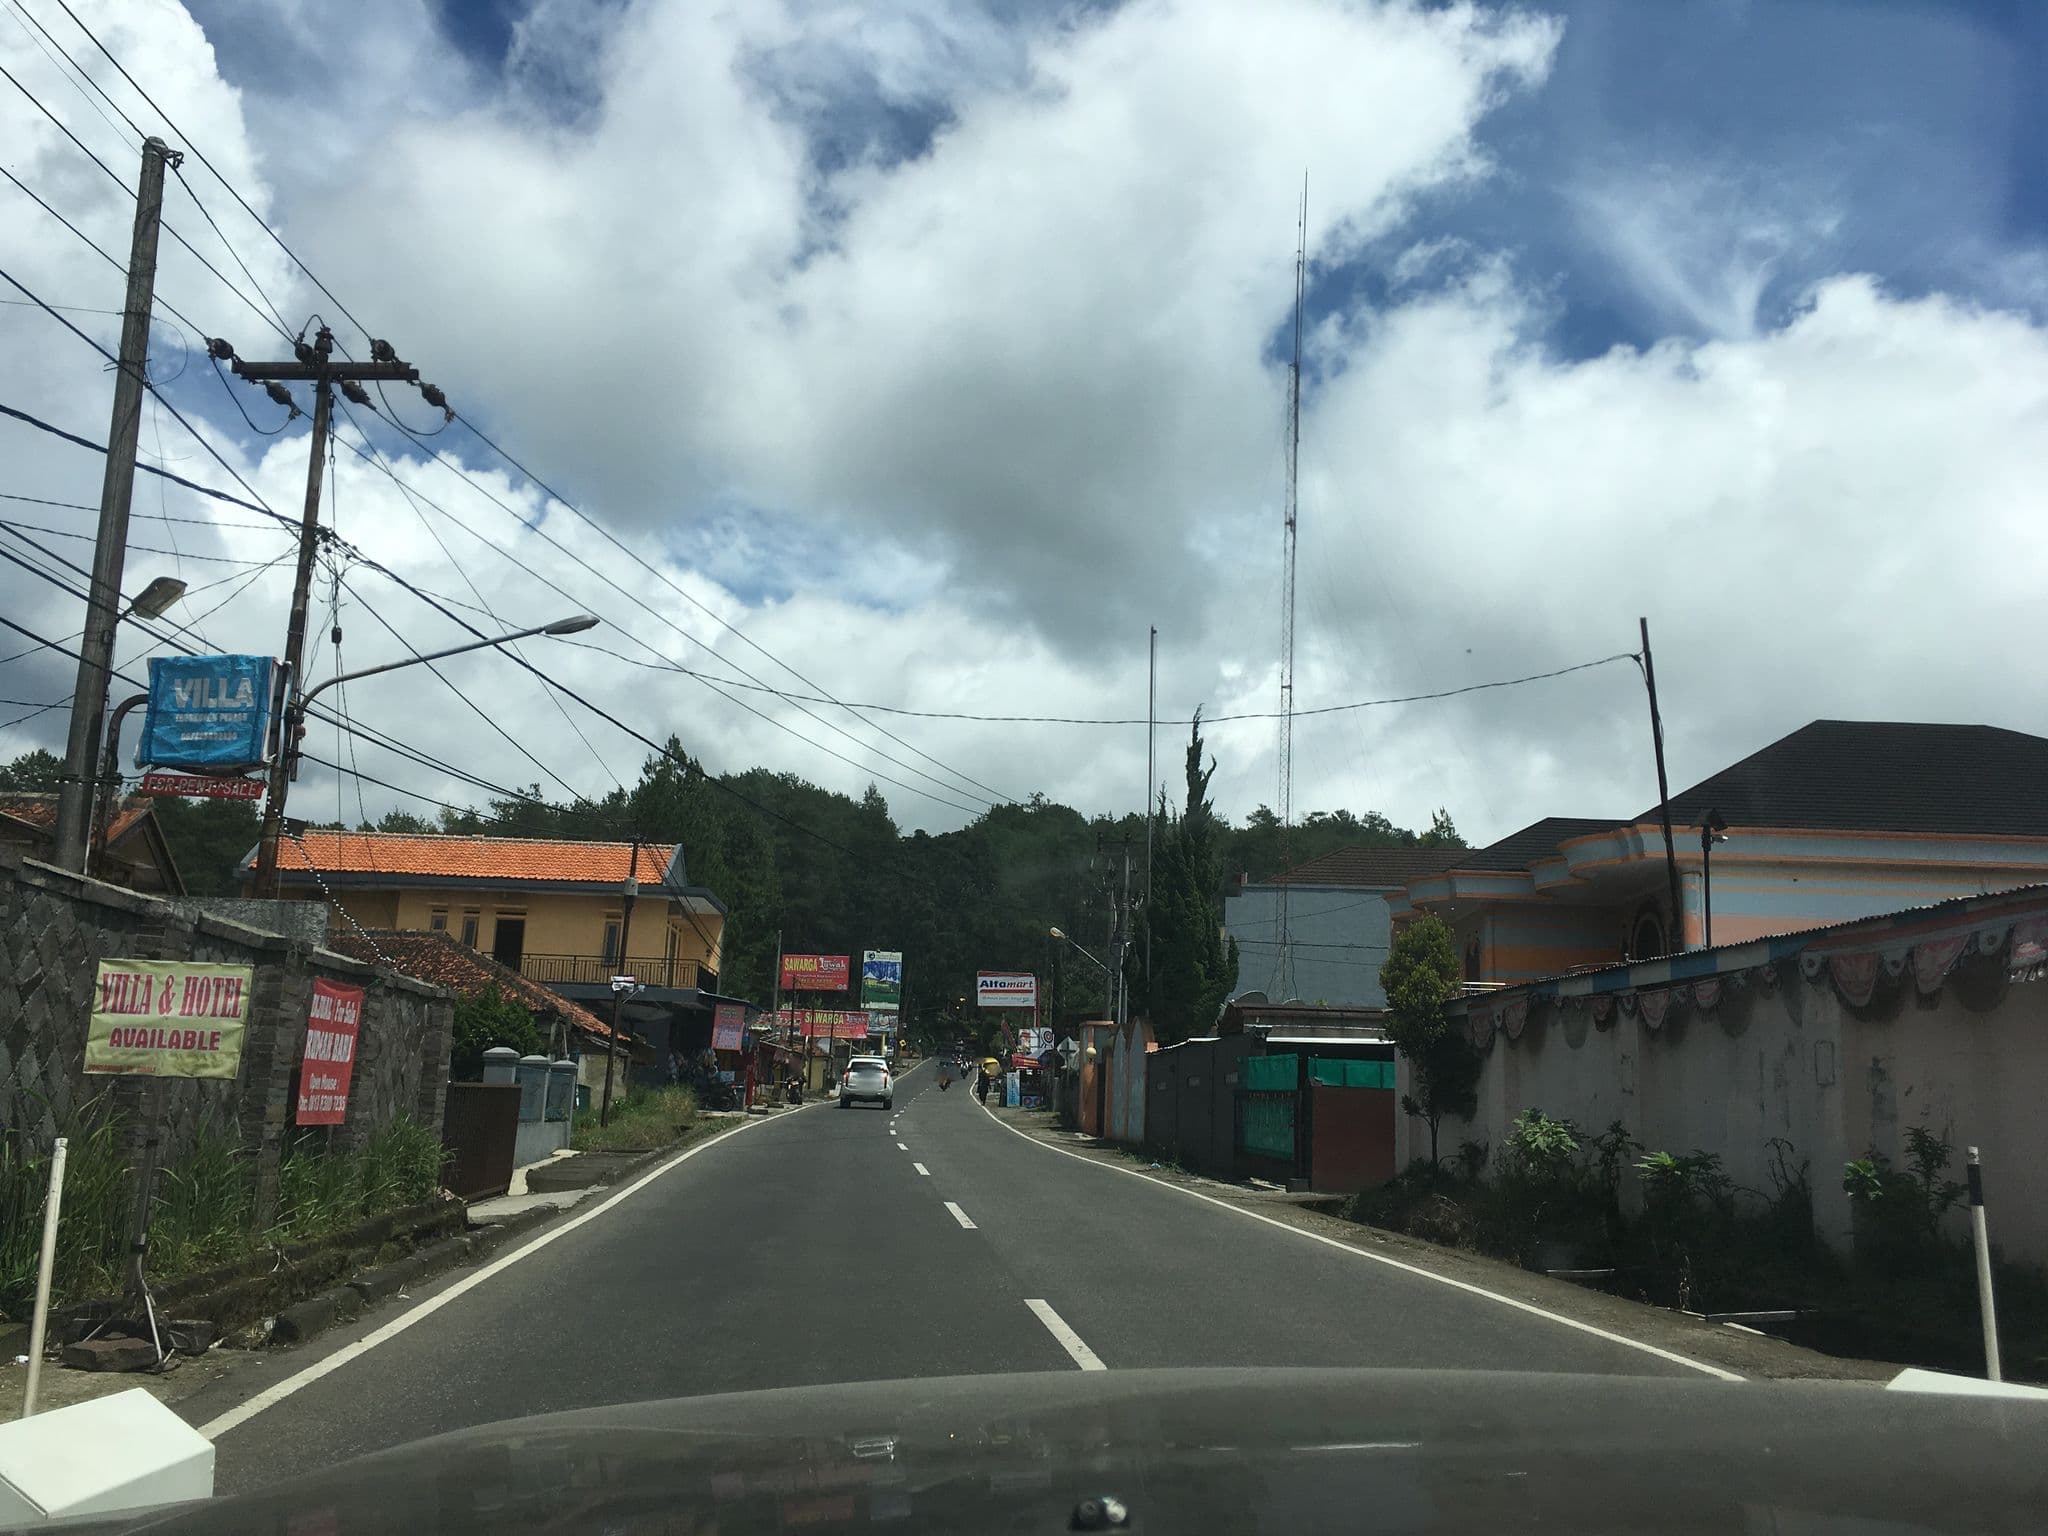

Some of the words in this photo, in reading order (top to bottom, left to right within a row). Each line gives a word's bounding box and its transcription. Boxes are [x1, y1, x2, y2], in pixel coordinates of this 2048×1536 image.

[175, 677, 254, 708] VILLA
[147, 777, 175, 791] FOR
[178, 778, 214, 793] RENT
[223, 782, 258, 797] SALE
[784, 957, 817, 971] SAWARGA
[980, 980, 1034, 988] Alfamart
[102, 973, 152, 1014] VILLA
[159, 975, 175, 1015] &
[179, 976, 243, 1018] HOTEL
[109, 1028, 221, 1051] AVAILABLE
